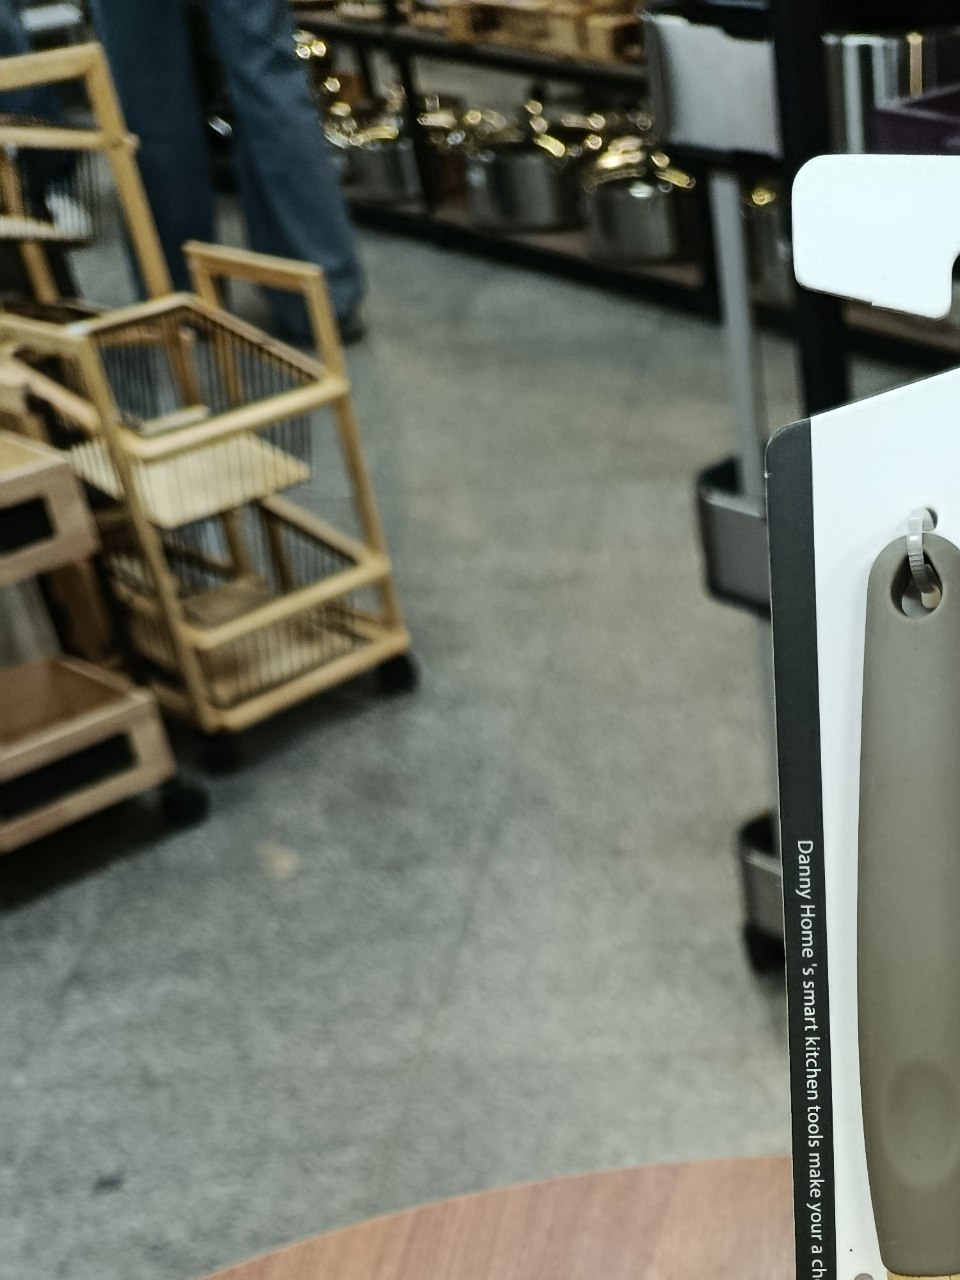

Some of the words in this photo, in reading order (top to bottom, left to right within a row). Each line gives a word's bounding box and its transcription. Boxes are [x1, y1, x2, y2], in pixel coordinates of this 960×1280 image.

[795, 840, 814, 900] Danny
[800, 904, 816, 958] Home
[802, 980, 819, 1031] smart
[804, 1036, 822, 1100] kitchen
[807, 1105, 824, 1148] tools
[808, 1153, 825, 1198] make
[806, 1203, 823, 1241] your
[811, 1245, 823, 1254] a
